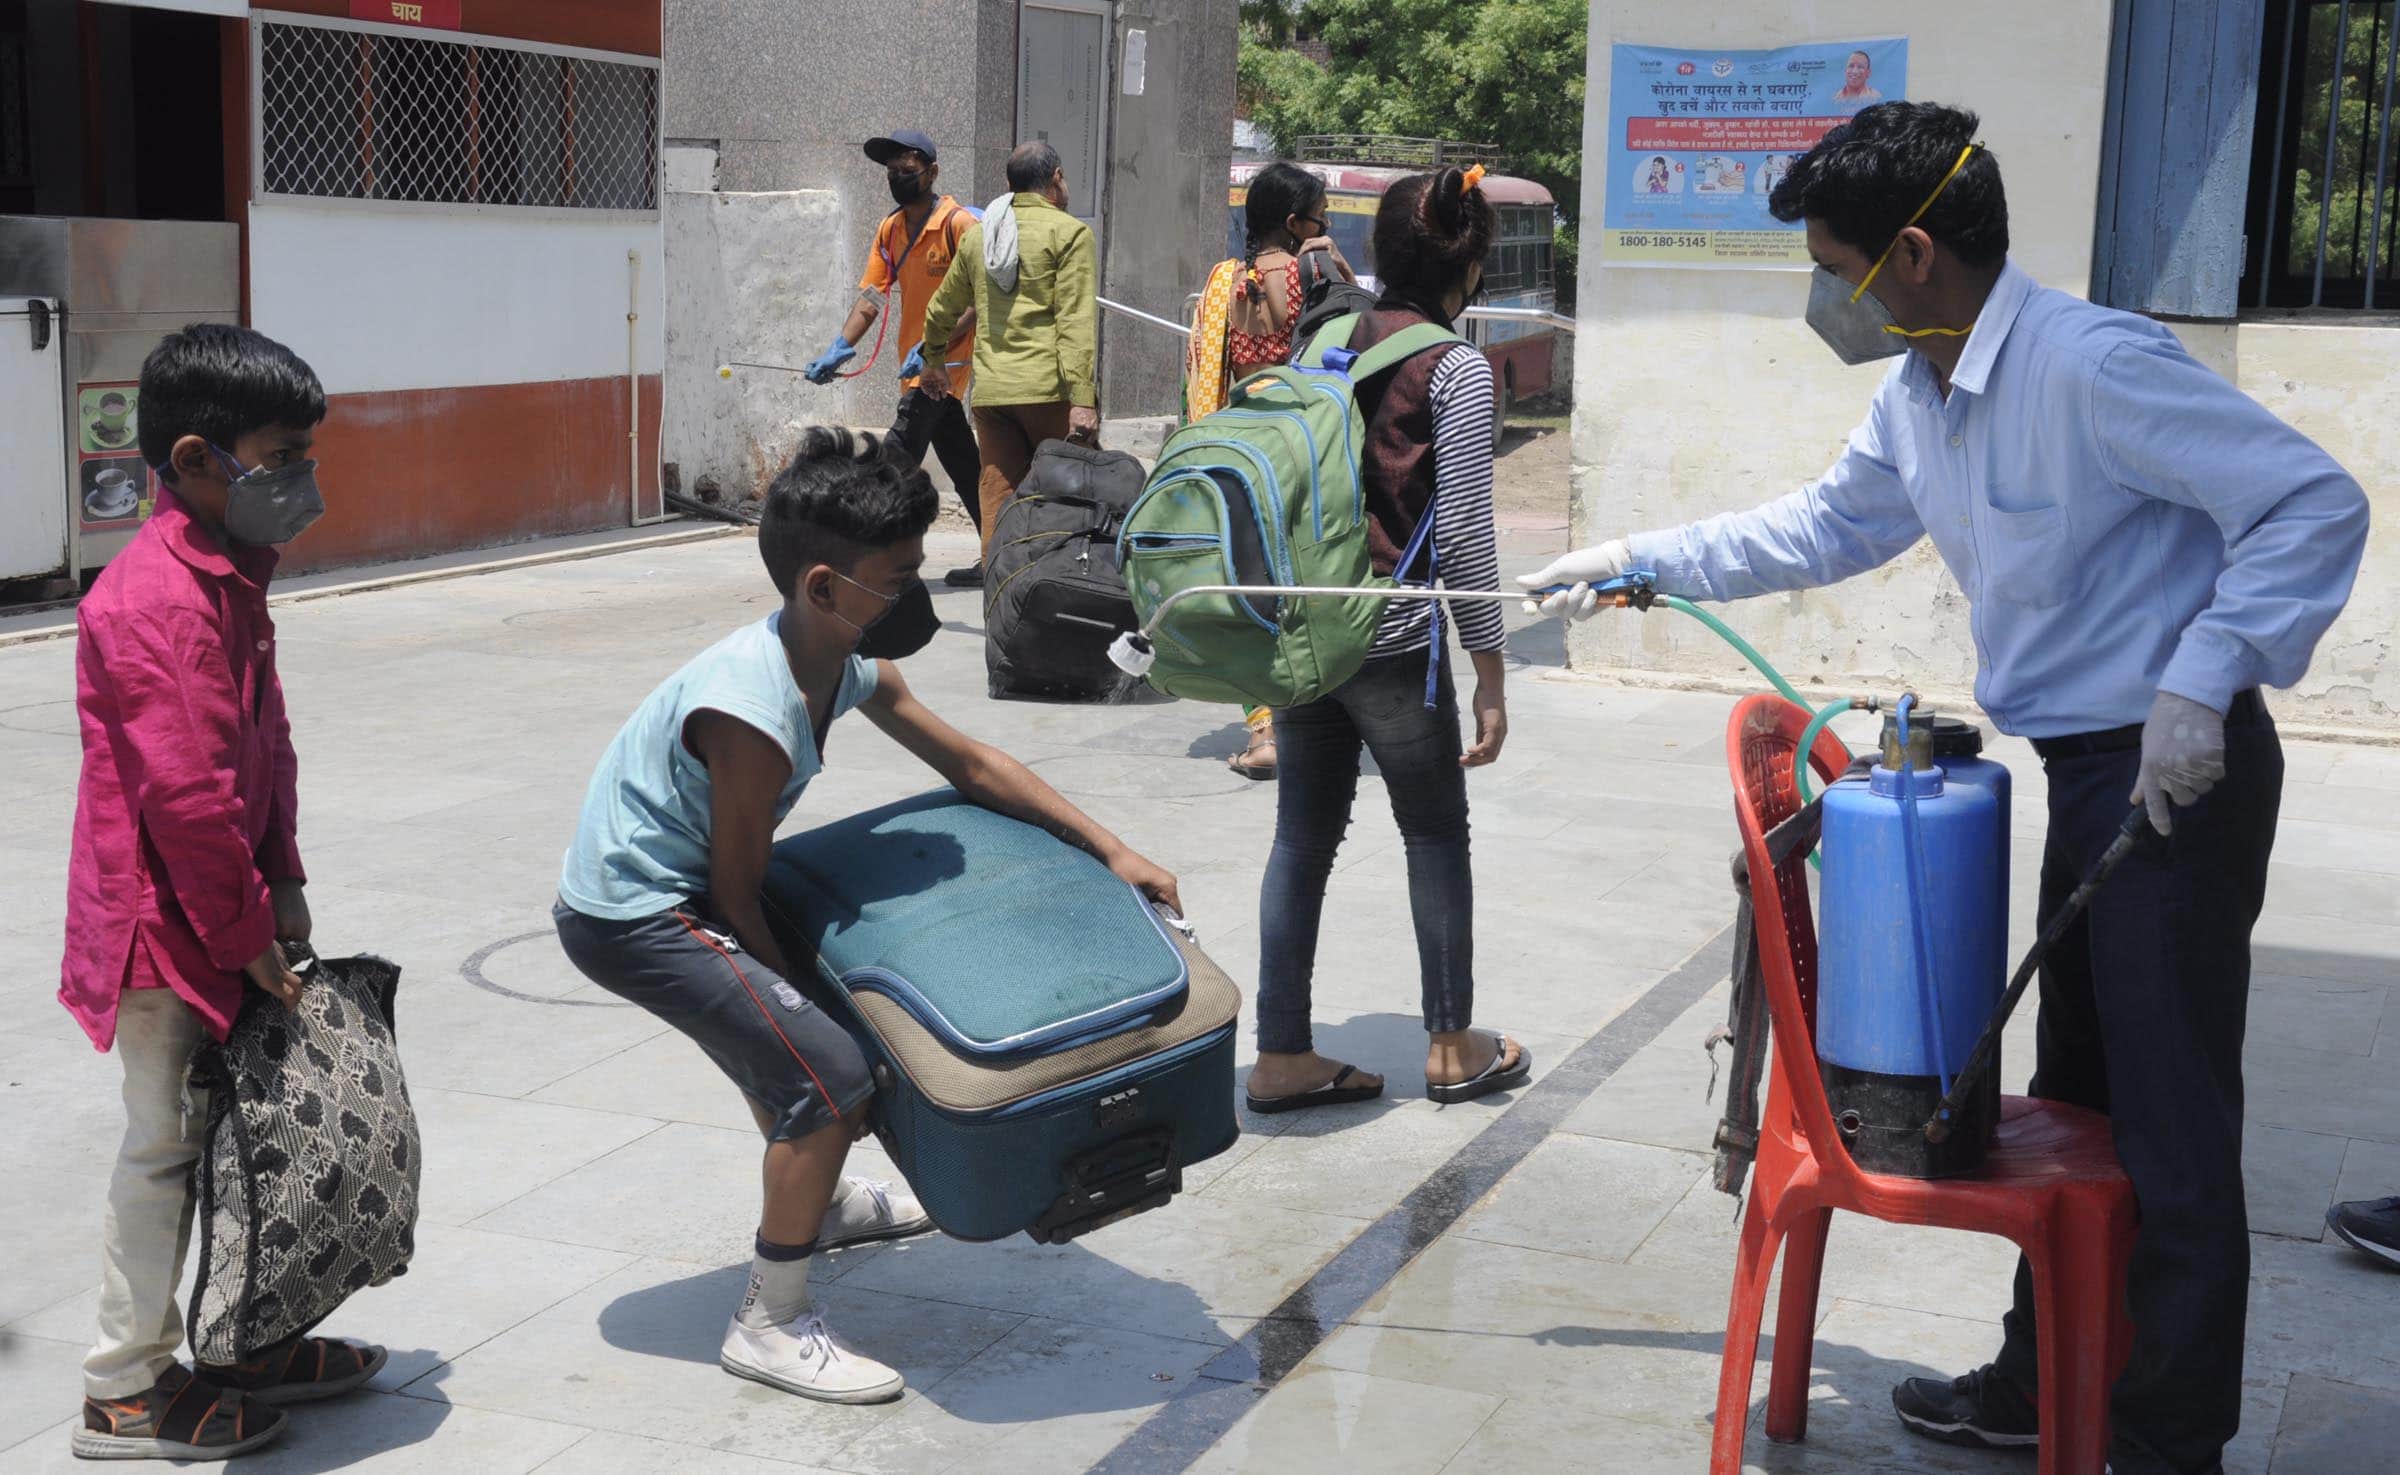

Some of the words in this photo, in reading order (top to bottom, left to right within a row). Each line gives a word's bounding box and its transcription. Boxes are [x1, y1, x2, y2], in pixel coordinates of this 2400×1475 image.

[391, 2, 422, 23] चाय
[1651, 81, 1688, 97] कोरोना
[1693, 84, 1733, 97] वायरस
[1738, 81, 1748, 96] से
[1752, 84, 1762, 96] न
[1658, 100, 1676, 116] खुद
[1704, 97, 1728, 112] और
[1732, 97, 1765, 112] सबको
[1619, 236, 1706, 248] 1800-180-5145
